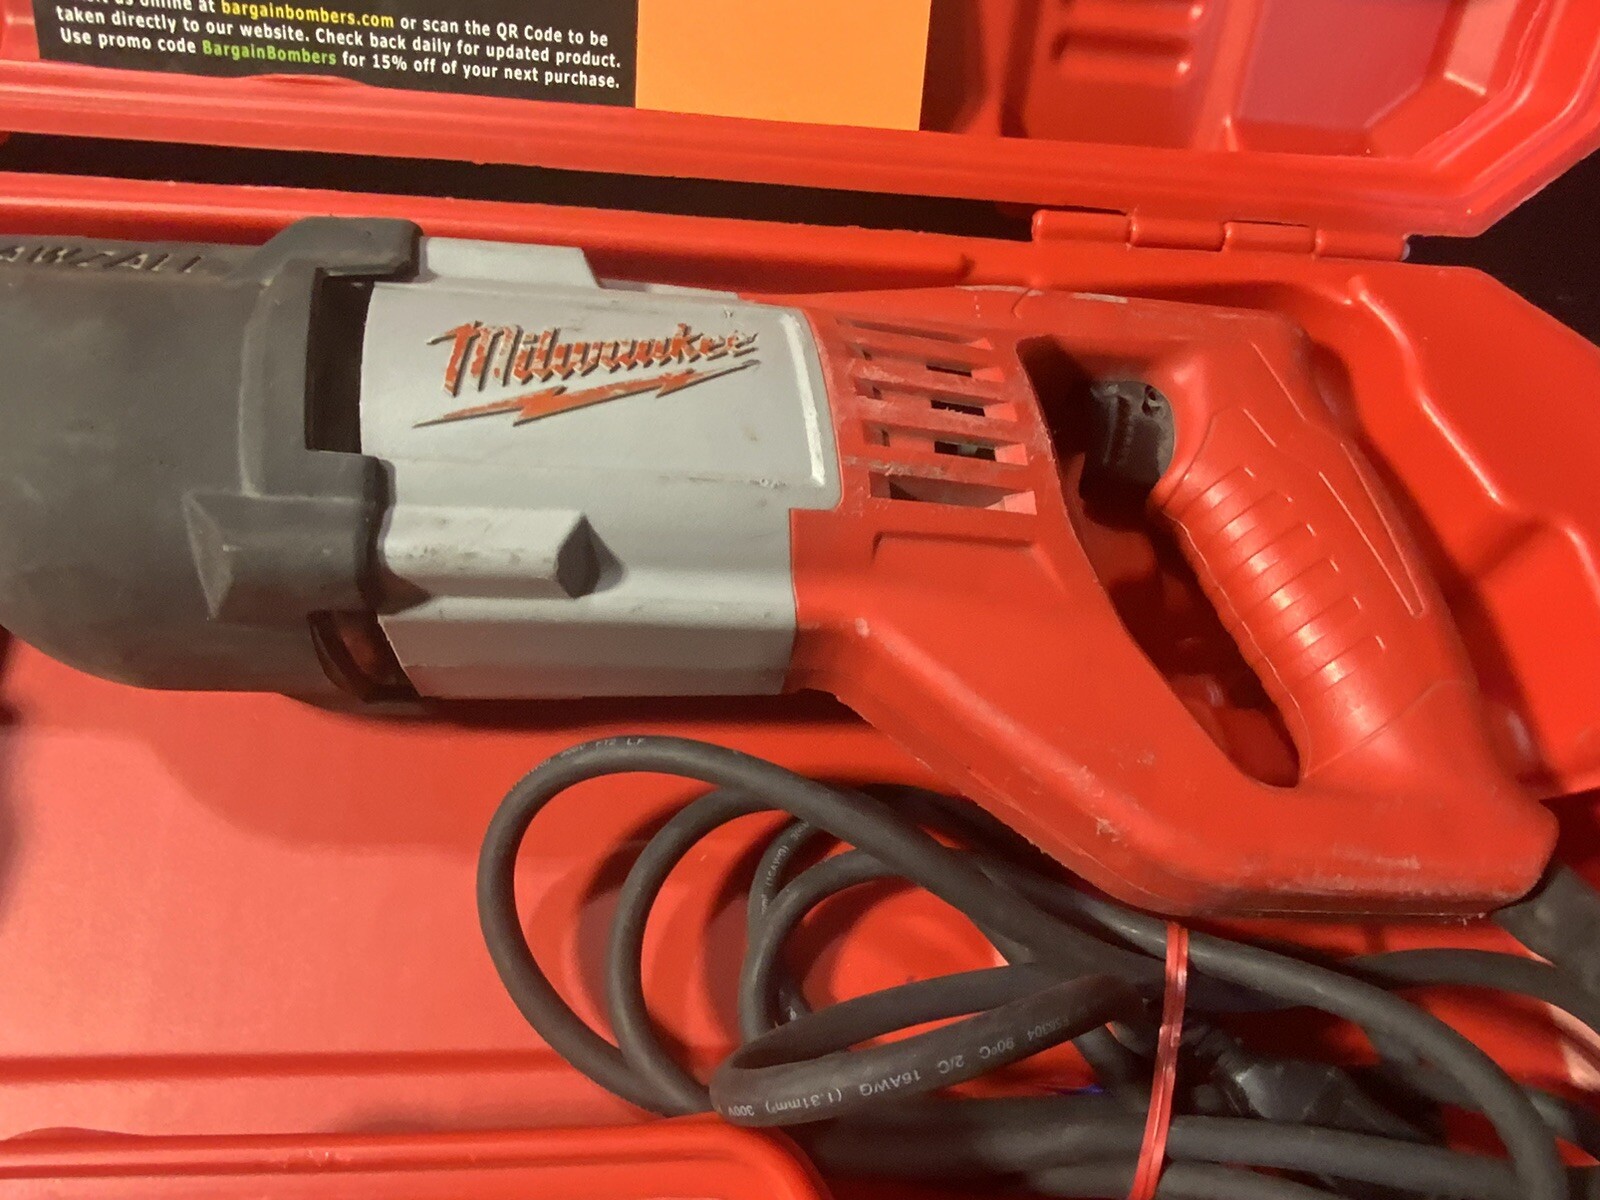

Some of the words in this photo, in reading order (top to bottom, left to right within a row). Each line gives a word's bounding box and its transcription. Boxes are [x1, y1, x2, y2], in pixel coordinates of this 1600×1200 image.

[56, 5, 105, 24] taken
[111, 10, 176, 34] directly
[183, 16, 200, 32] to
[206, 21, 234, 36] our
[240, 22, 310, 42] website.
[316, 28, 363, 47] Check
[370, 32, 406, 50] back
[412, 37, 450, 57] daily
[457, 39, 480, 57] for
[486, 43, 549, 64] updated
[555, 47, 621, 69] product.
[199, 0, 216, 13] at
[221, 0, 394, 28] bargainbombers.com
[401, 17, 417, 30] or
[423, 19, 459, 34] scan
[465, 20, 491, 37] the
[497, 23, 518, 40] QR
[524, 25, 563, 43] Code
[568, 29, 584, 45] to
[590, 30, 608, 47] be
[60, 27, 92, 45] Use
[98, 33, 151, 50] promo
[158, 37, 197, 54] code
[202, 40, 337, 65] BargainBombers
[342, 51, 366, 67] for
[372, 54, 407, 71] 15%
[413, 57, 437, 74] off
[442, 60, 458, 75] of
[462, 64, 498, 79] your
[504, 66, 539, 82] next
[544, 69, 620, 89] purchase.
[425, 320, 759, 397] Milwaukee
[858, 1069, 922, 1098] 16AWG
